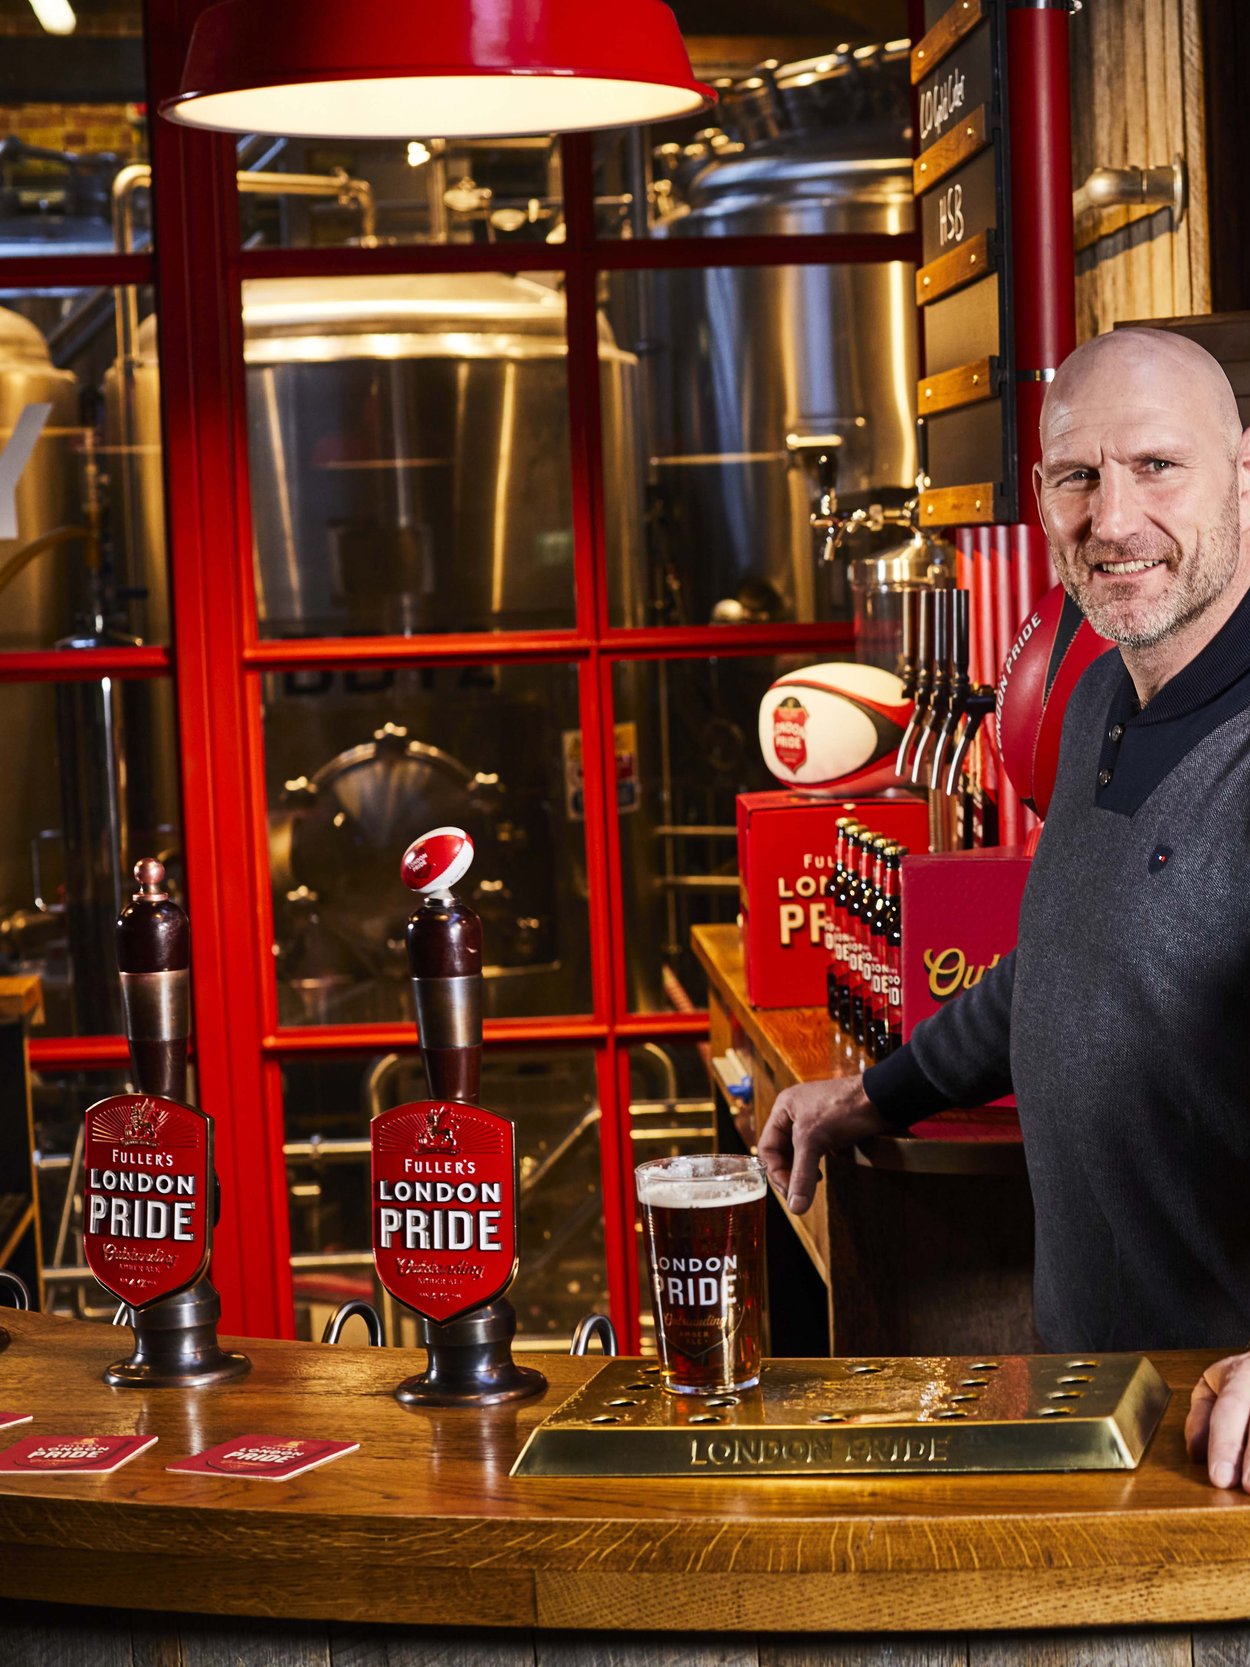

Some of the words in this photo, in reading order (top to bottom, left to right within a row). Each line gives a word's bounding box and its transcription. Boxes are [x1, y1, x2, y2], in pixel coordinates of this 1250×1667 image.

[939, 184, 965, 246] HSB
[1005, 611, 1042, 675] PRIDE
[112, 1149, 174, 1167] FULLER'S
[404, 1158, 476, 1176] FULLER'S
[90, 1168, 195, 1195] LONDON
[379, 1180, 501, 1203] LONDON
[89, 1194, 196, 1241] PRIDE
[380, 1207, 502, 1251] PRIDE
[27, 1451, 104, 1459] PRIDE
[223, 1451, 296, 1463] PRIDE
[239, 1447, 304, 1457] LONDON
[690, 1438, 833, 1465] LONDON
[845, 1436, 948, 1463] PRIDE
